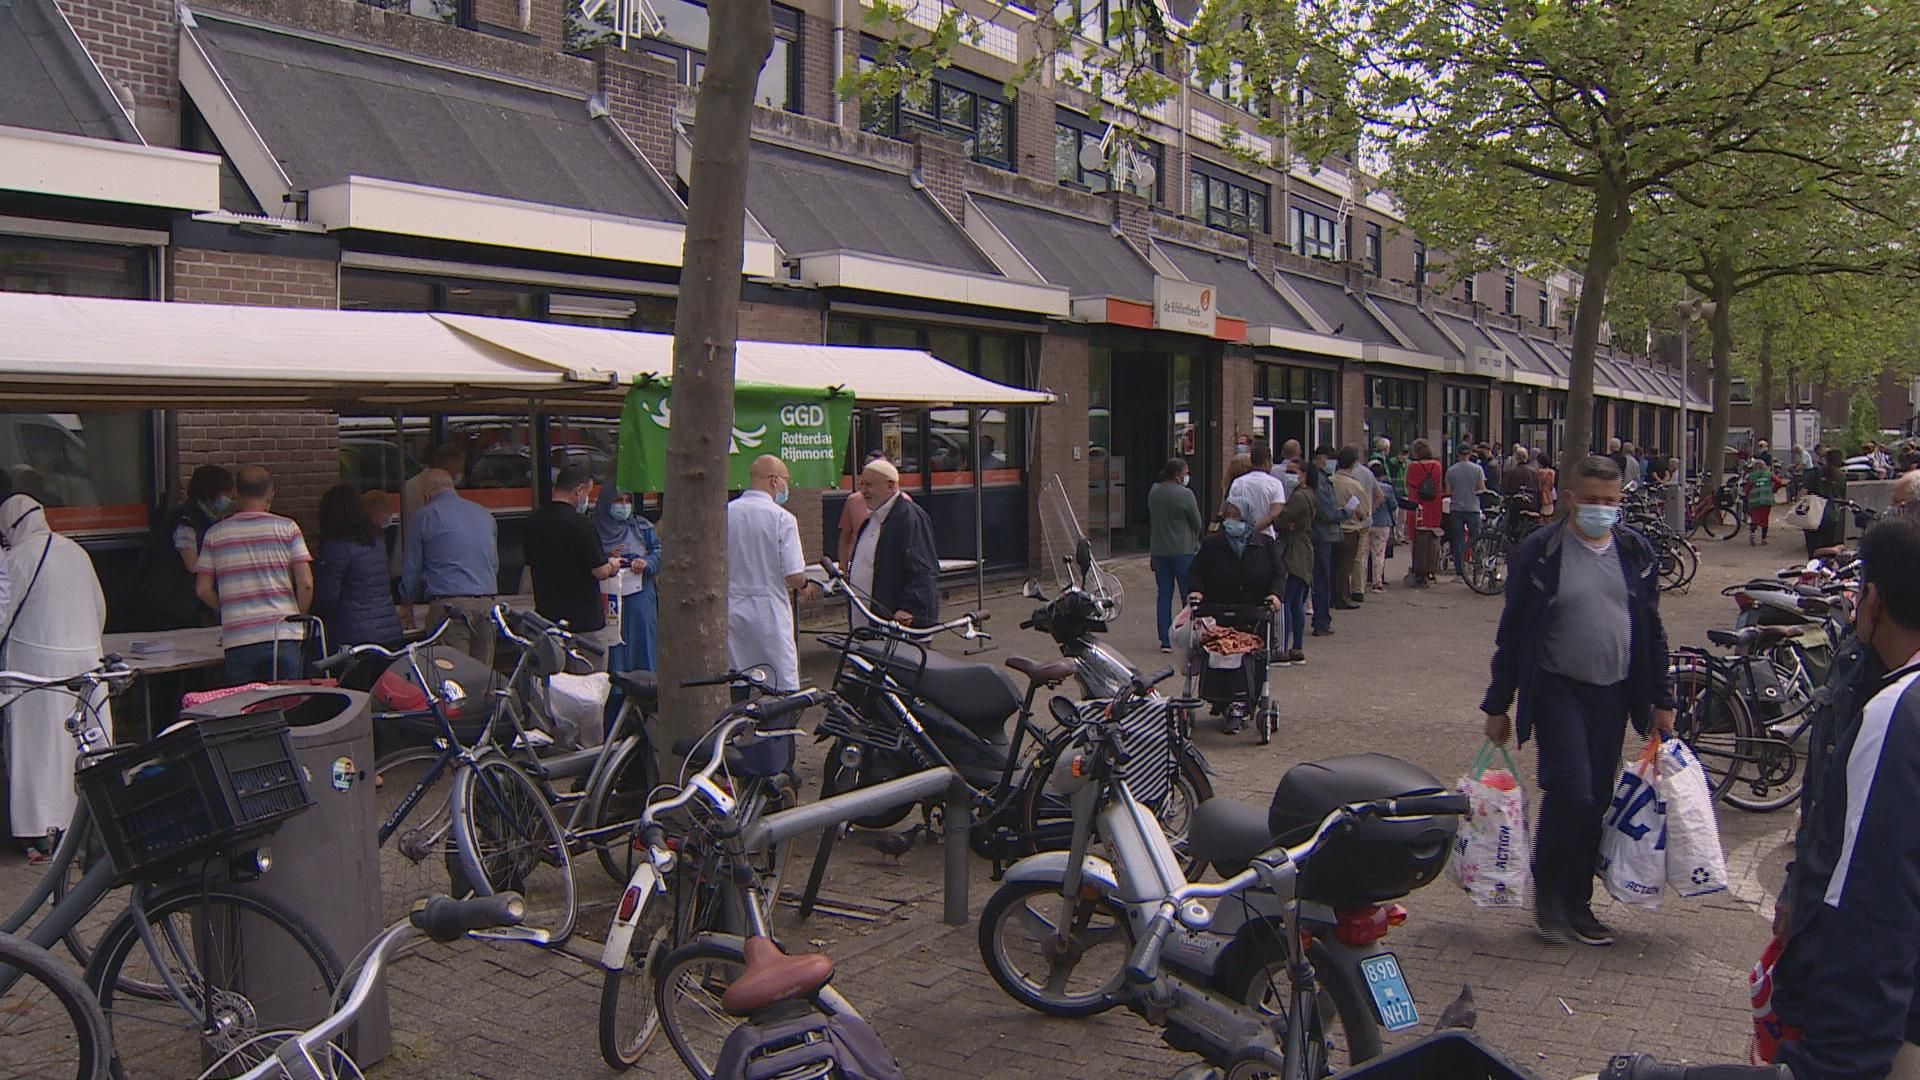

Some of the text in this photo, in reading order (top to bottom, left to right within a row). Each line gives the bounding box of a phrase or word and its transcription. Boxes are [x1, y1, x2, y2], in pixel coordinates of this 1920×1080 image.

[1163, 299, 1170, 312] de
[780, 404, 824, 427] GGD
[1495, 825, 1511, 869] ACTION
[1624, 880, 1661, 895] ACTION
[1366, 960, 1397, 982] 89D
[1381, 1001, 1411, 1024] NH7
